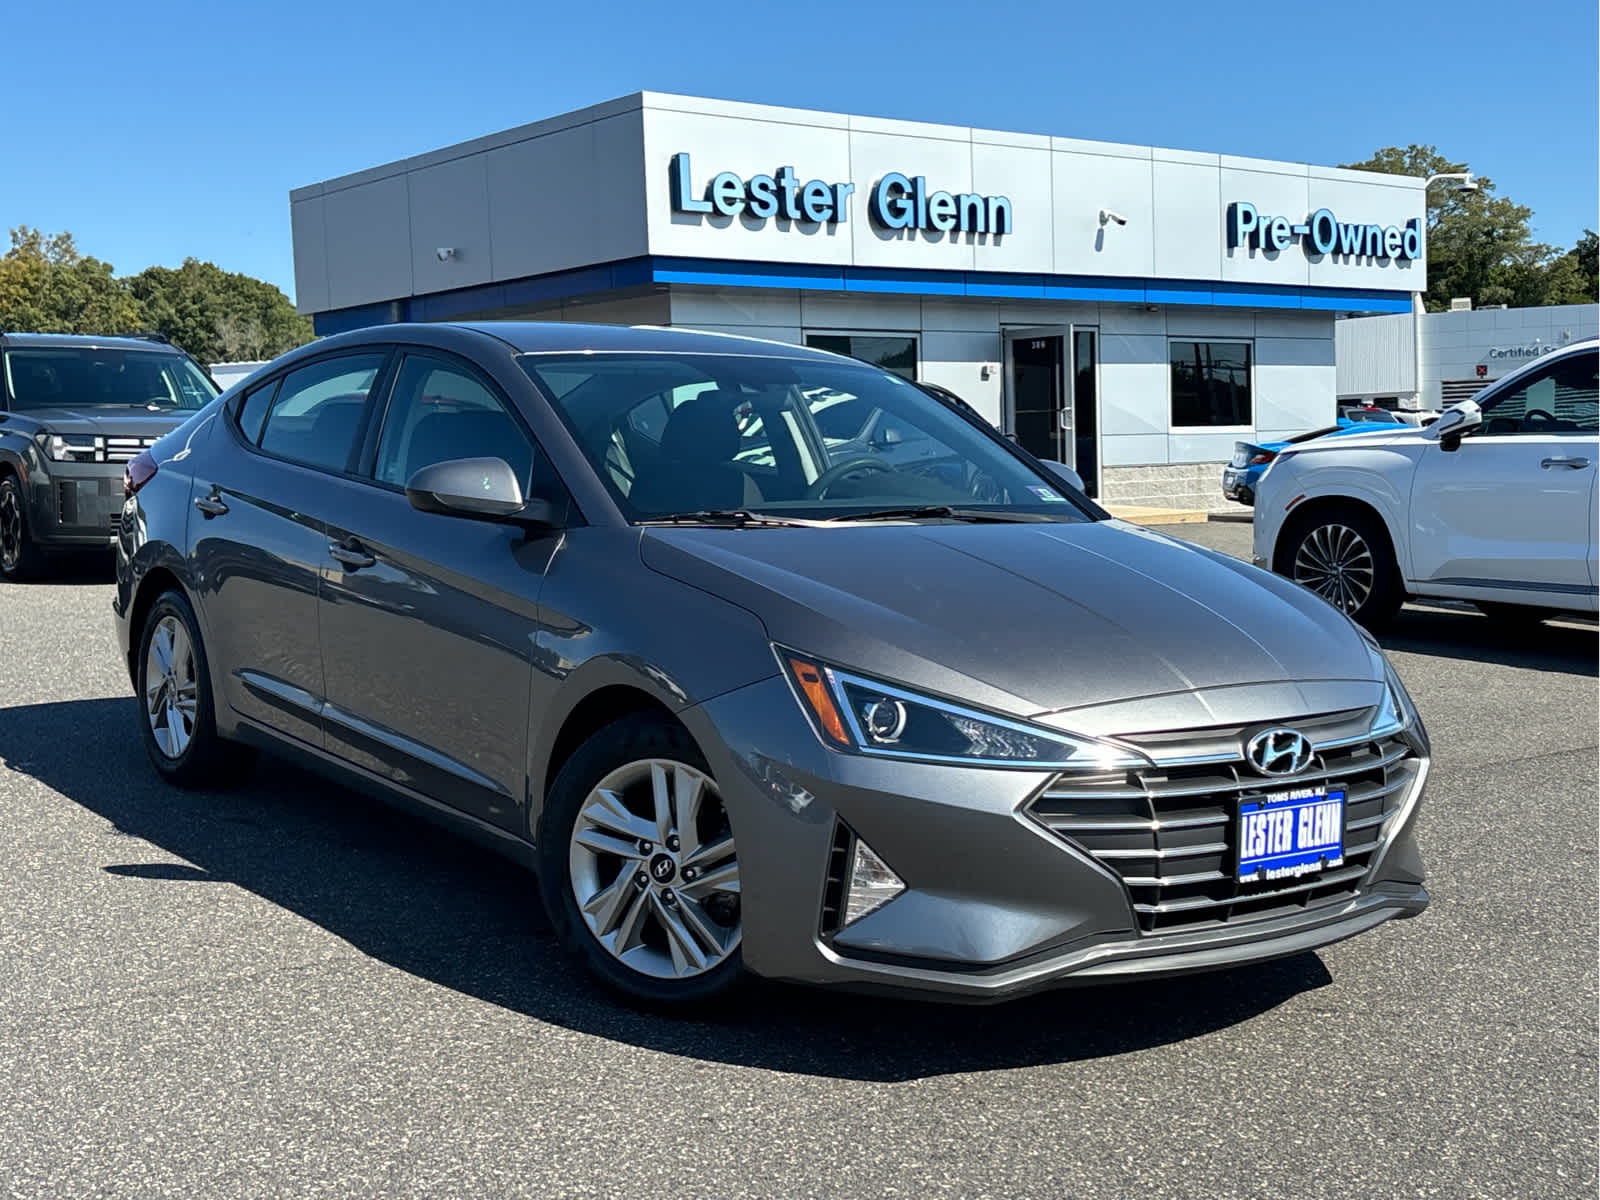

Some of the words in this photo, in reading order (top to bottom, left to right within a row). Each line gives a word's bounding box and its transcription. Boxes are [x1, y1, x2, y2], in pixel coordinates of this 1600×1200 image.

[671, 152, 855, 224] Lester
[873, 171, 1012, 235] Glenn
[1228, 201, 1422, 261] Pre-Owned
[1489, 347, 1540, 359] Certified
[1266, 792, 1289, 804] TOMS
[1240, 809, 1294, 859] LESTER
[1297, 802, 1341, 849] GLENN
